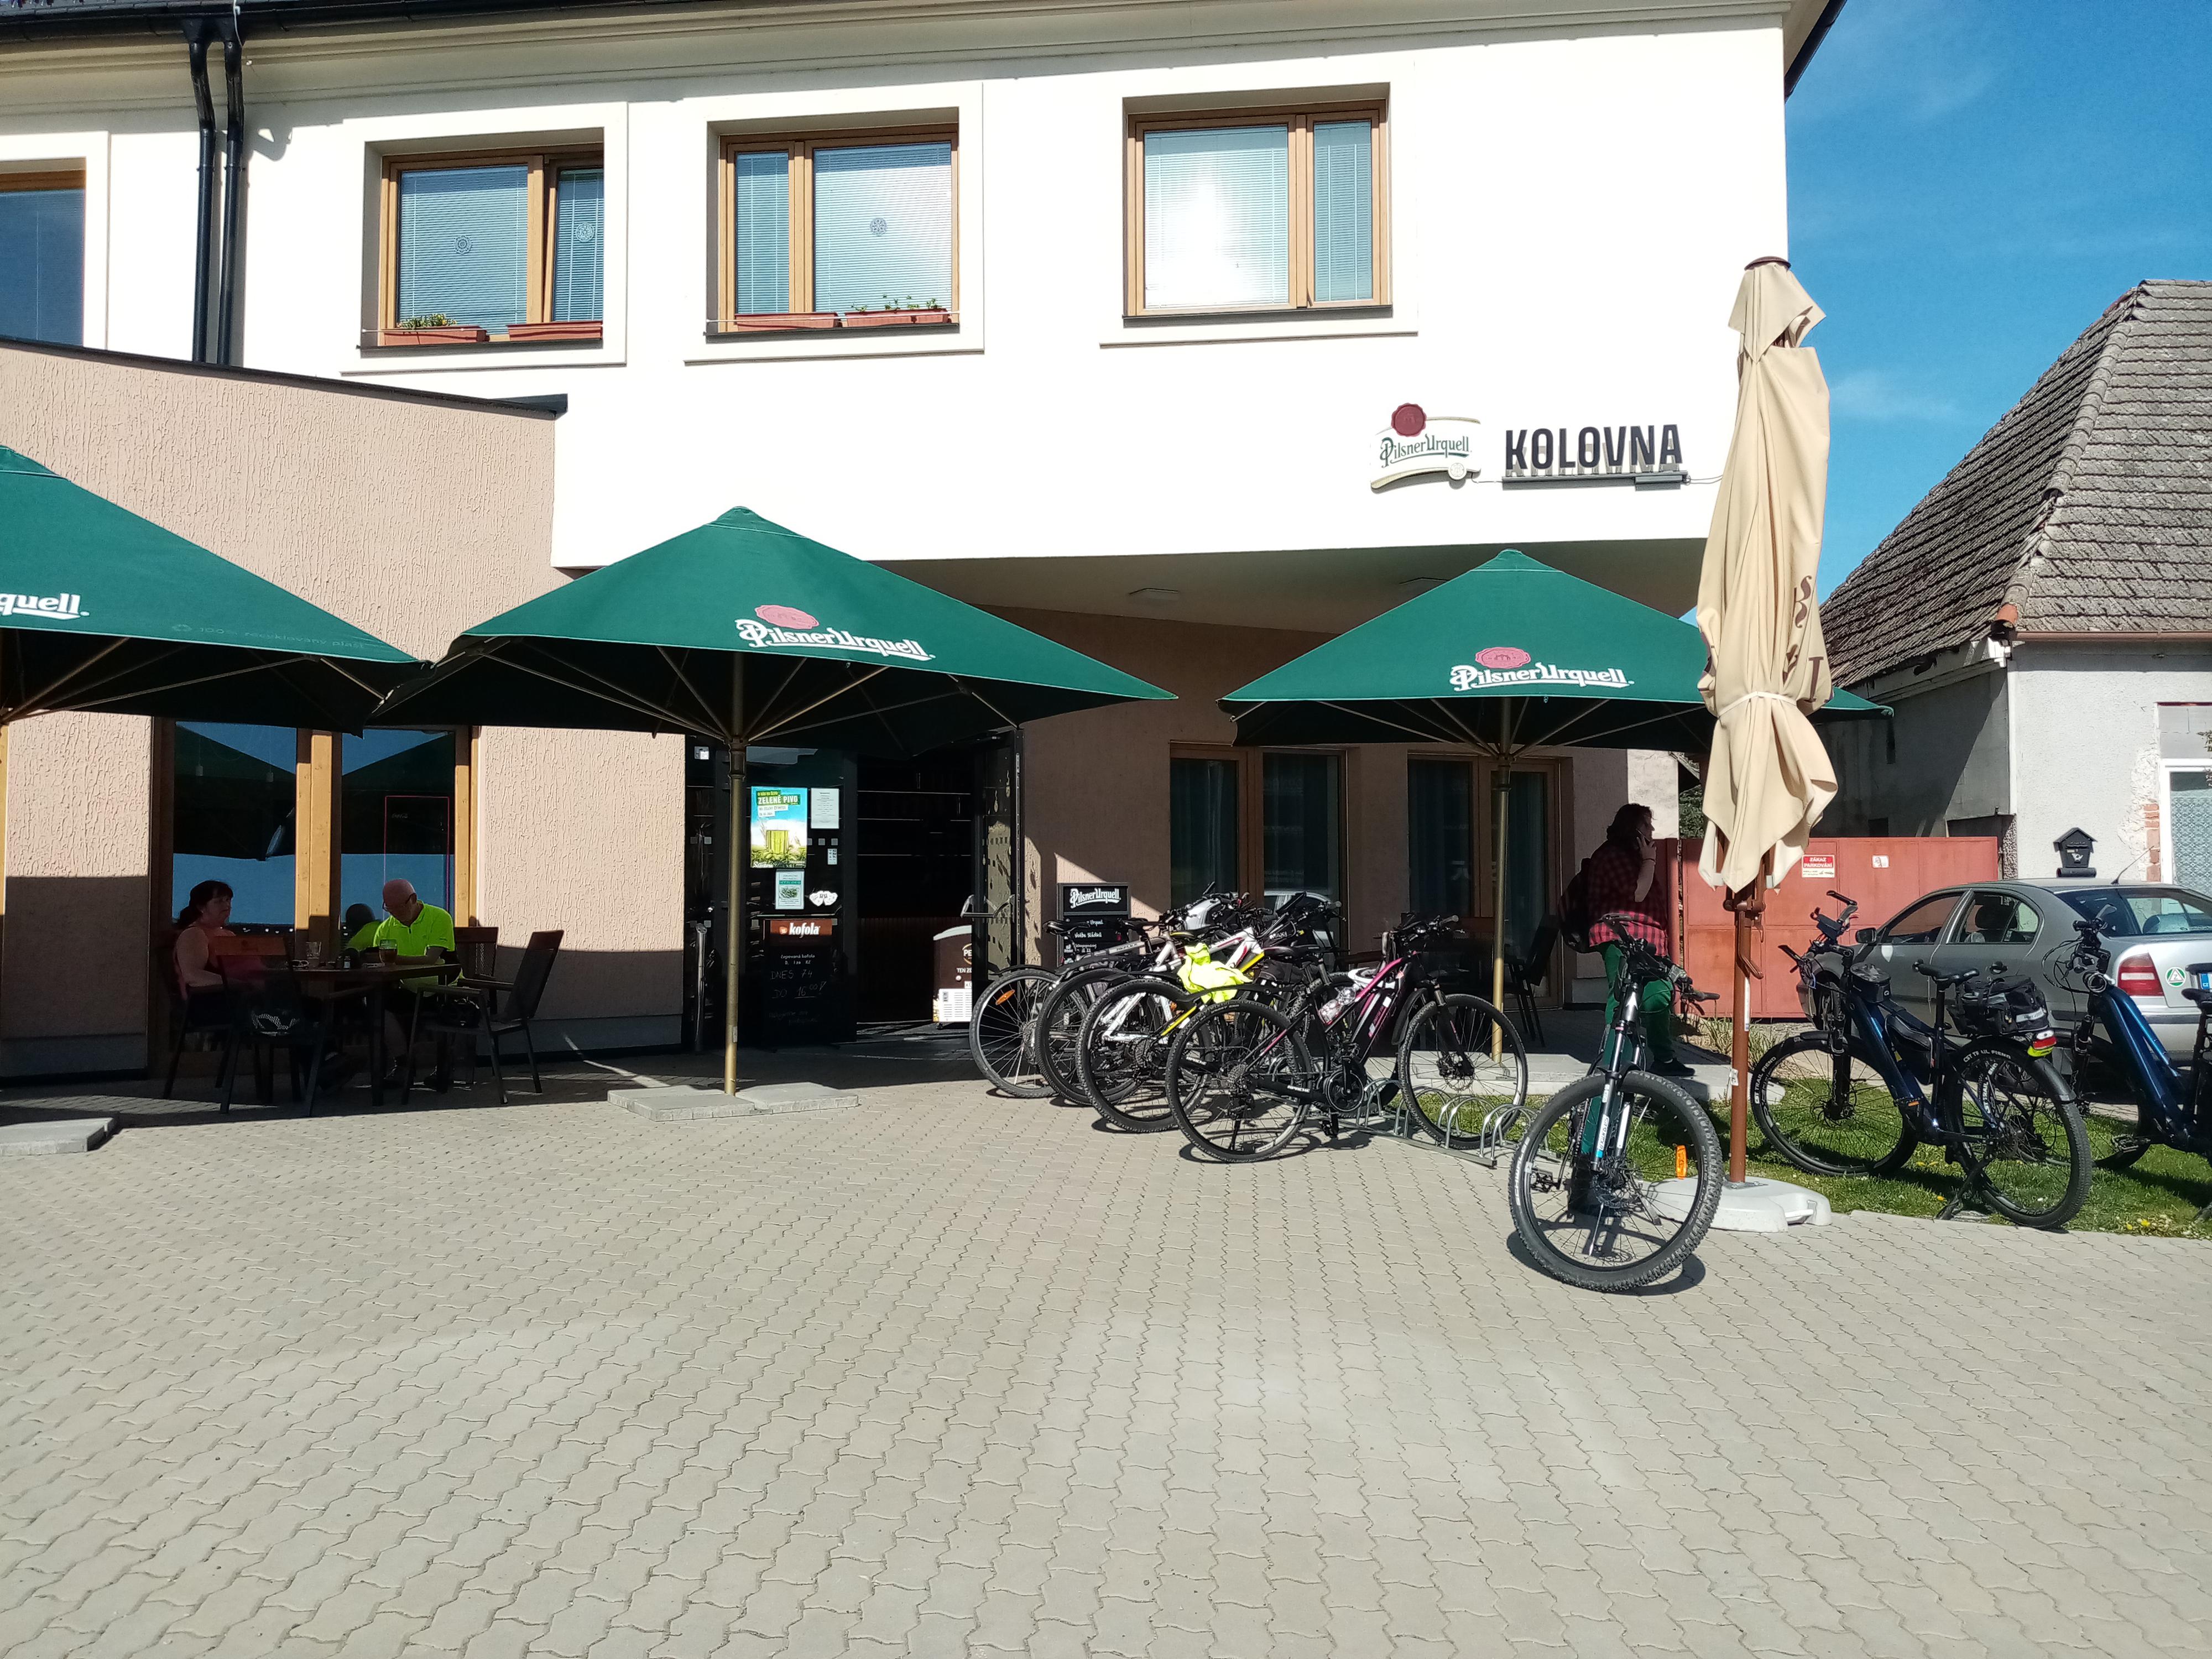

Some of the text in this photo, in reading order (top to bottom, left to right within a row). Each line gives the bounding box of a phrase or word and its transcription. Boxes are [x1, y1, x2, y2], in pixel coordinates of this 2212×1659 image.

[1505, 424, 1683, 469] KOLOVNA
[758, 795, 781, 804] ZELENÉ
[789, 922, 820, 938] kofola
[771, 969, 794, 979] DNES
[1755, 1073, 1764, 1091] TRAIL
[1761, 1057, 1776, 1072] FIEND
[1515, 1136, 1530, 1206] SCHWALBE
